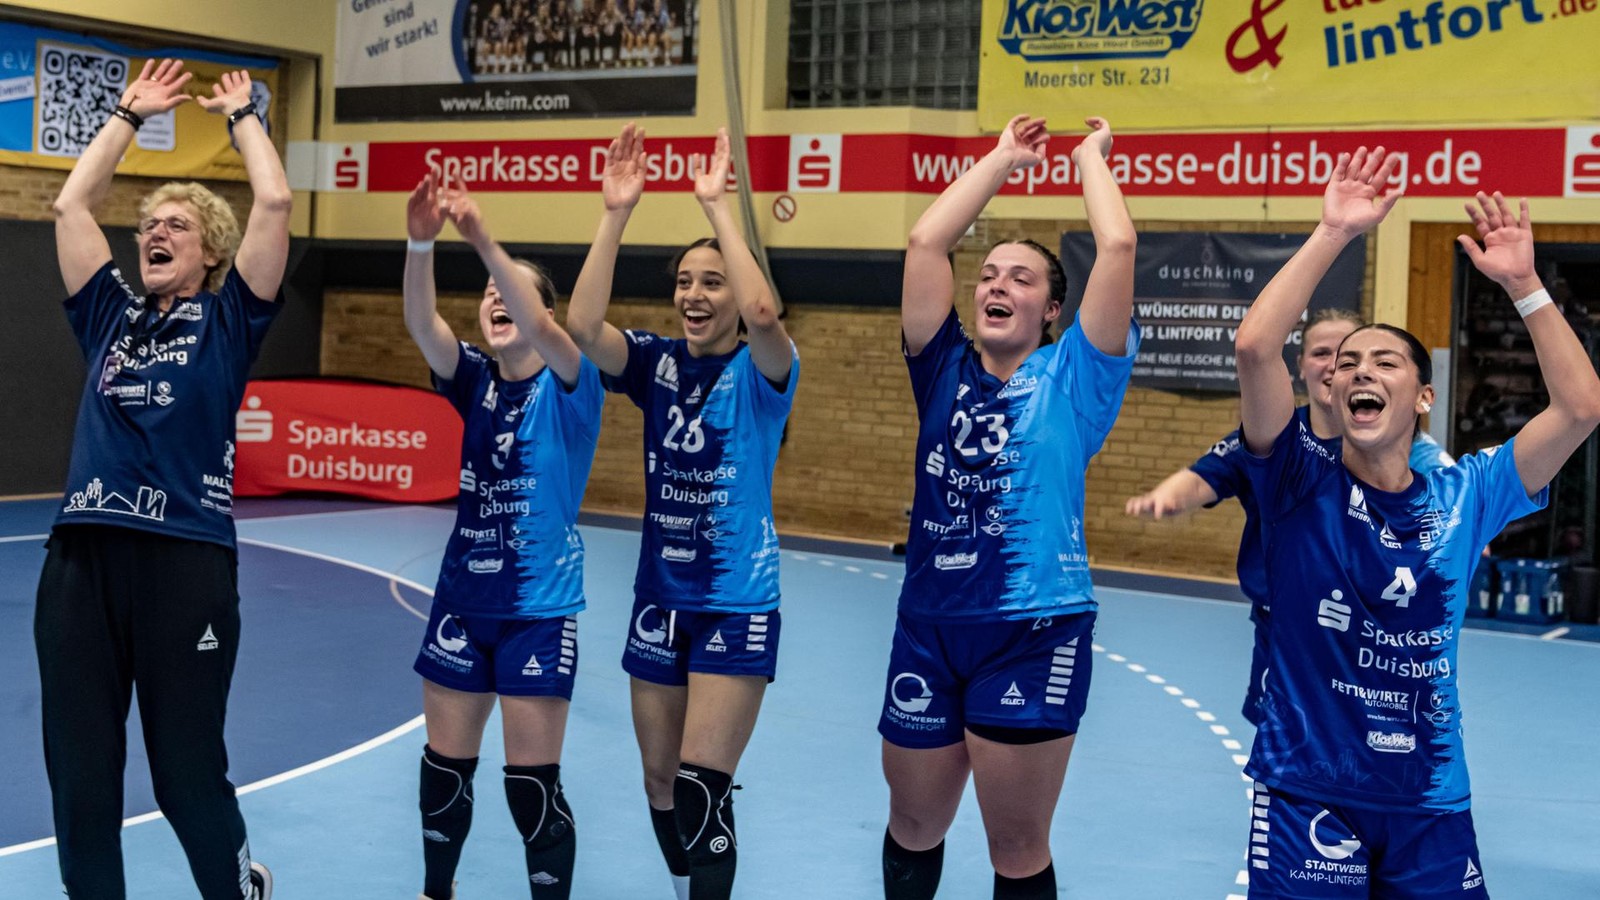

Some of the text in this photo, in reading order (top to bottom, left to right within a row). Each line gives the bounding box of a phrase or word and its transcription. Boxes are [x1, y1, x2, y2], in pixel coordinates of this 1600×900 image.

[384, 2, 415, 28] sind
[365, 18, 438, 57] wir stark!
[1102, 69, 1134, 86] Str.
[1140, 67, 1171, 85] 231
[440, 90, 570, 112] www.keim.com
[424, 146, 580, 189] Sparkasse
[912, 138, 1482, 194] wwspaasse-duisbg.de
[1158, 264, 1255, 283] duschking
[1138, 301, 1218, 319] WÜNSCHEN
[1157, 327, 1225, 342] LINTFORT
[1158, 353, 1183, 364] NEUE
[1184, 354, 1223, 367] DUSCHE
[288, 420, 428, 450] Sparkasse
[662, 404, 705, 454] 26
[951, 410, 1010, 456] 23
[491, 432, 514, 470] 3
[288, 453, 414, 489] Duisburg
[1380, 566, 1418, 608] 4
[1360, 619, 1453, 647] Sparkase
[197, 641, 219, 651] SELECT
[428, 642, 474, 668] STADTWERKE
[630, 637, 678, 659] STADTWERKE
[705, 644, 727, 652] SELECT
[1358, 647, 1451, 679] Duisburg
[1331, 678, 1410, 703] FETT&WIRTZ
[1000, 698, 1026, 706] SELECT
[1364, 700, 1409, 711] AUTOMOBILE
[888, 705, 947, 724] STADTWERKE
[1289, 869, 1367, 886] KAMP-LINTFORT
[1305, 859, 1367, 874] STADTWERKE
[1462, 875, 1483, 891] SELECT
